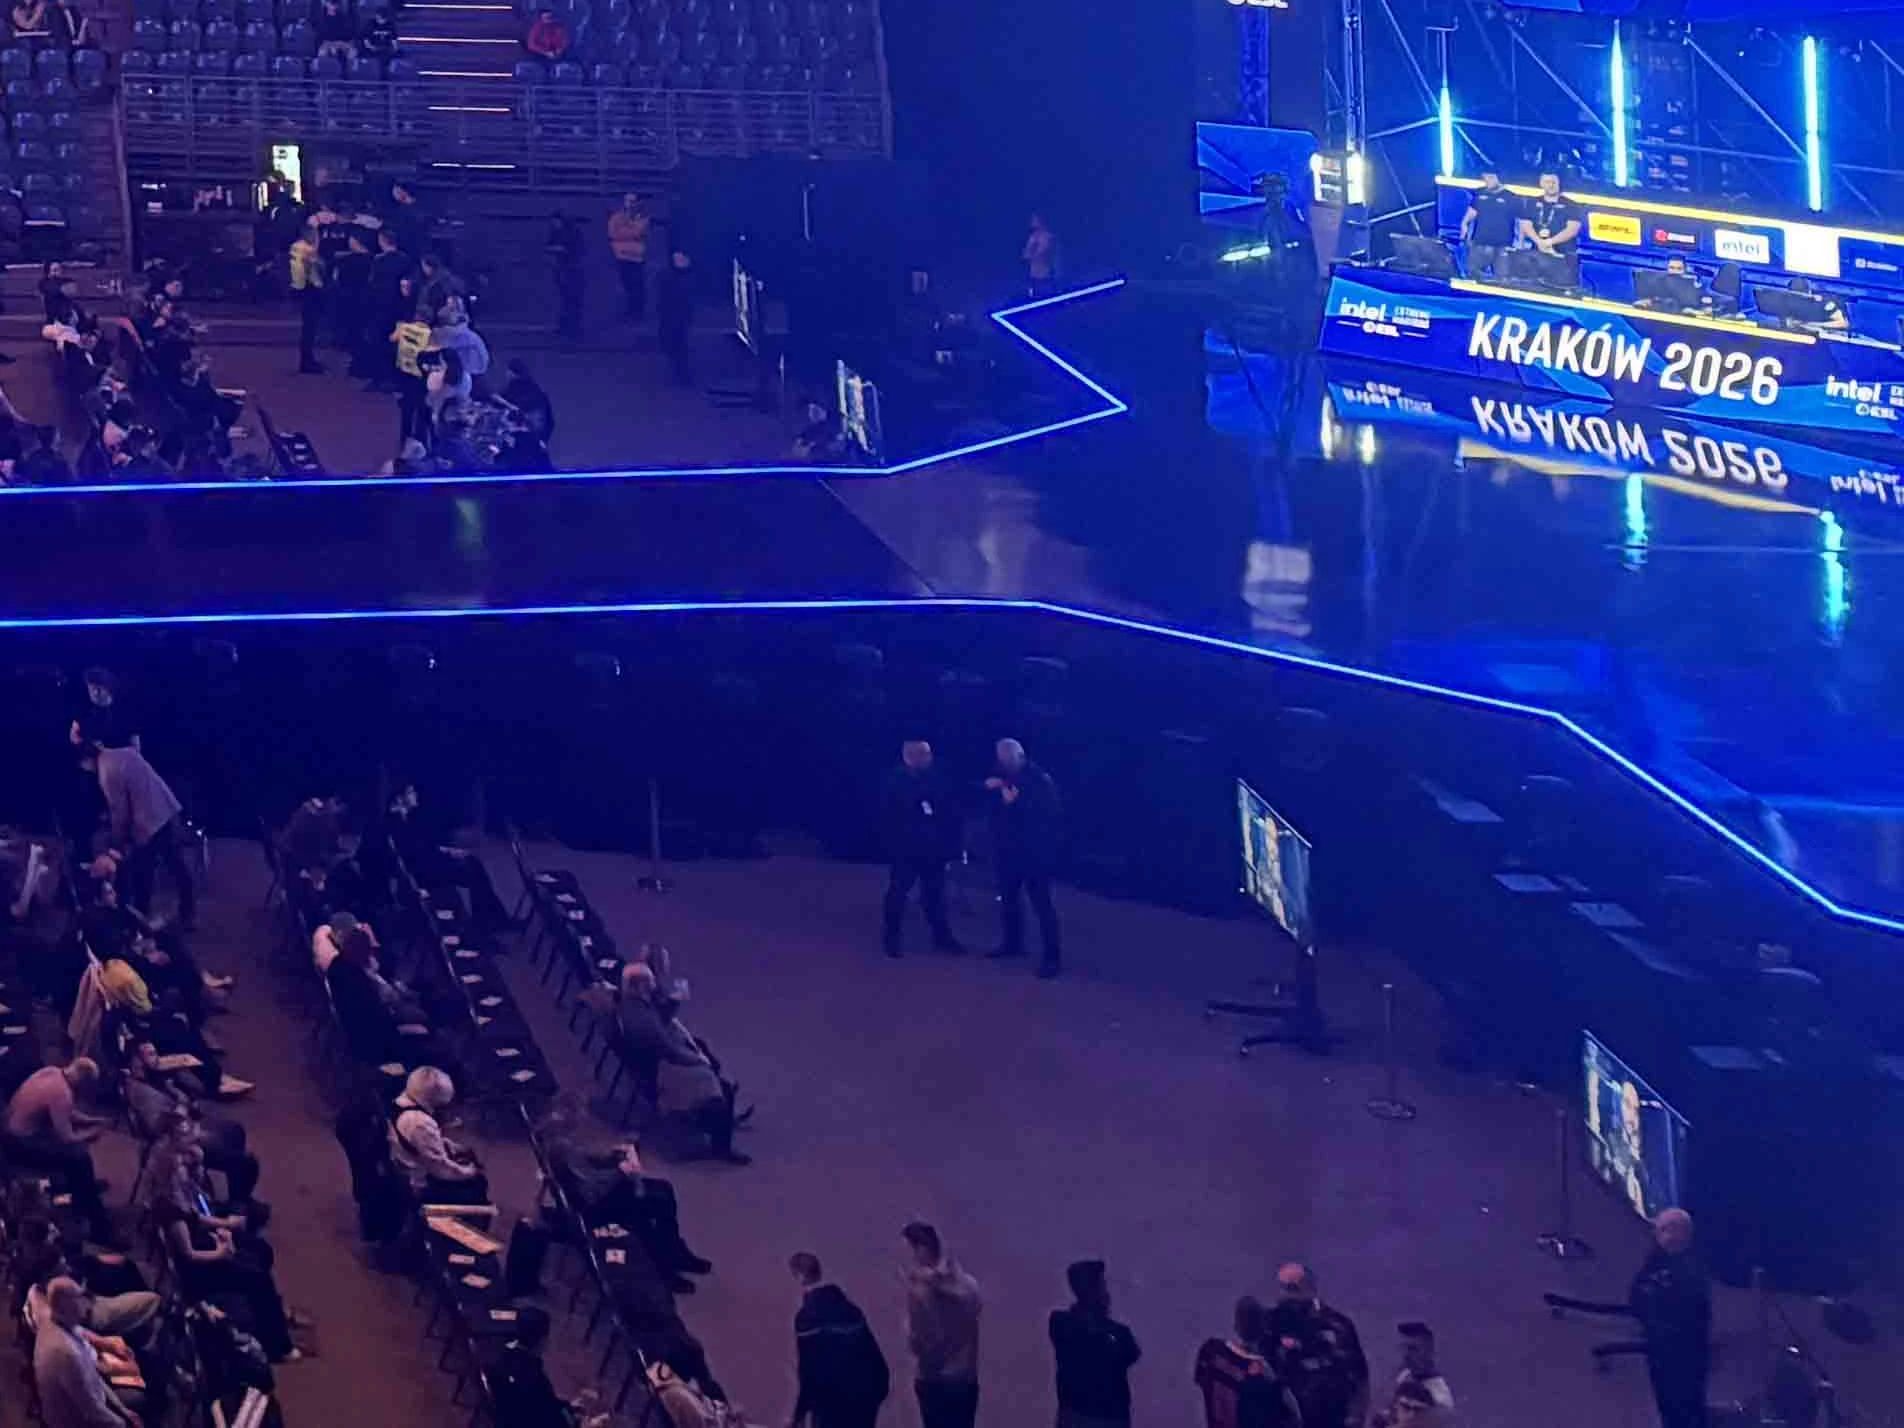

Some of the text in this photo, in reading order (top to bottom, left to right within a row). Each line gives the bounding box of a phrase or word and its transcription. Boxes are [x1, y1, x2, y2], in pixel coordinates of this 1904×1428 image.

[1340, 297, 1387, 322] intel
[1468, 312, 1783, 405] KRAKÓW 2026
[1826, 376, 1882, 403] intel
